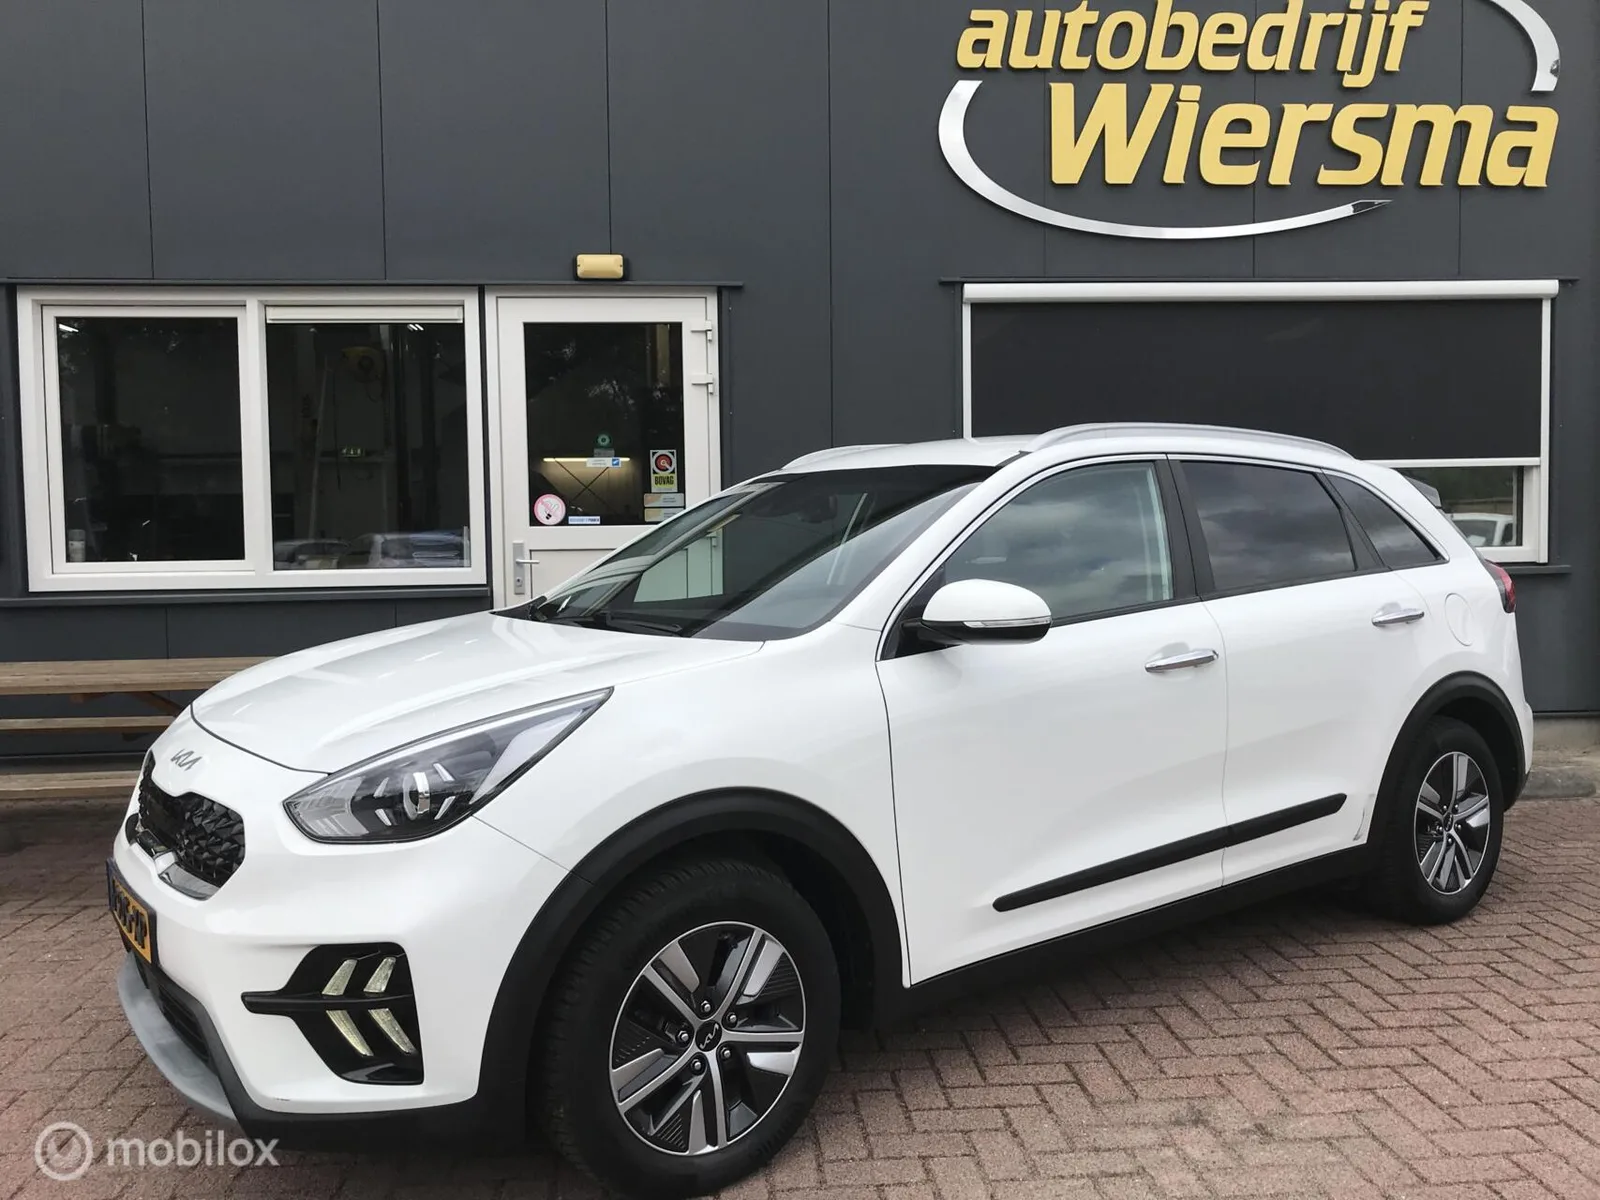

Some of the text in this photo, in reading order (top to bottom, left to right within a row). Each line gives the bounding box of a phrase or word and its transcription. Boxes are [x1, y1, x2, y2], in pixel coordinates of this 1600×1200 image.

[957, 0, 1429, 88] autobedrijf
[1050, 82, 1560, 187] Wiersma
[654, 475, 674, 485] BOVAG
